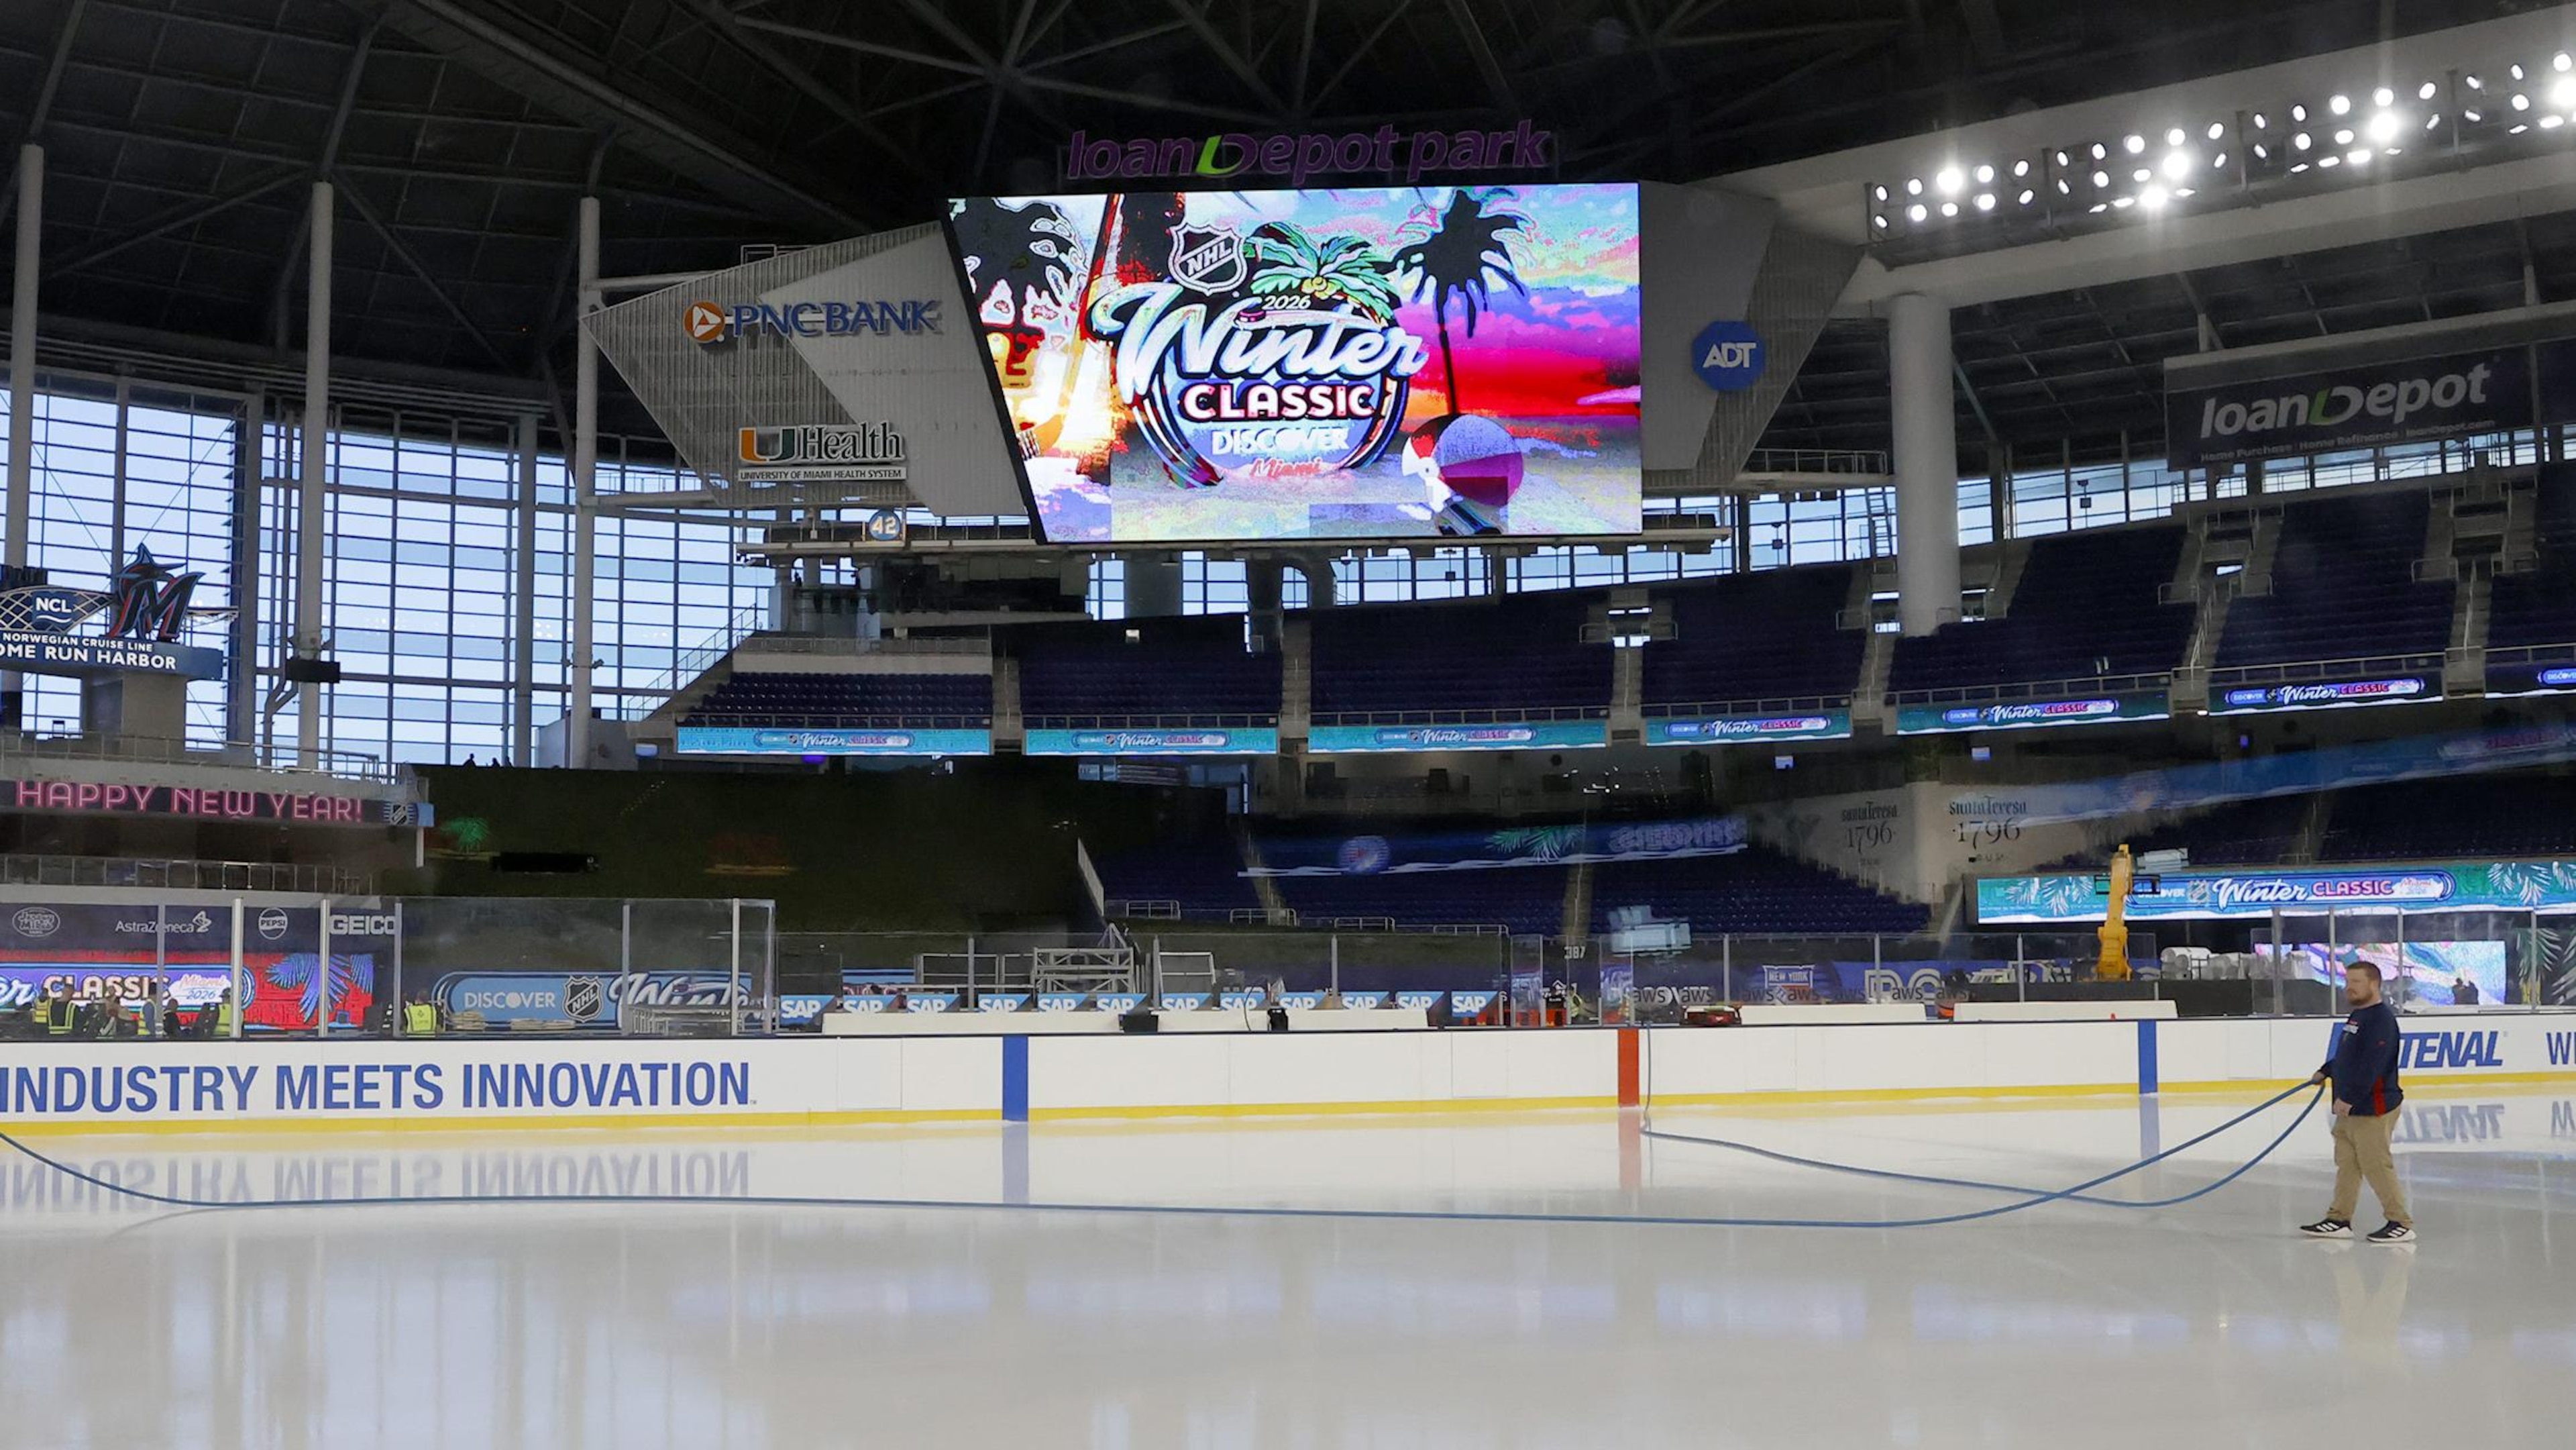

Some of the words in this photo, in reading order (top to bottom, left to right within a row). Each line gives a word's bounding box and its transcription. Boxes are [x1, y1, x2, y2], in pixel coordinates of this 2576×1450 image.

[1068, 125, 1393, 185] loanDepot
[1407, 119, 1551, 183] park
[1186, 242, 1233, 275] NHL
[1263, 295, 1311, 309] 2026
[1091, 282, 1430, 404] Winter
[1703, 342, 1756, 368] ADT
[1183, 384, 1375, 419] CLASSIC
[2200, 363, 2491, 439] loanDepot
[1212, 427, 1349, 456] DISCOVER
[2300, 437, 2334, 450] Home
[2337, 431, 2399, 446] Refinance
[741, 471, 788, 480] UNIVERSITY
[790, 471, 801, 479] OF
[804, 470, 832, 478] MIAMI
[835, 470, 865, 478] HEALTH
[868, 470, 901, 478] SYSTEM
[872, 515, 896, 534] 42
[36, 597, 72, 613] NCL
[3, 633, 78, 645] NORWEGIAN
[82, 638, 123, 649] CRUISE
[127, 642, 153, 652] LINE
[45, 645, 89, 662] RUN
[97, 649, 176, 670] HARBOR
[2281, 685, 2339, 705] Winter
[2340, 684, 2389, 694] CLASSIC
[1991, 705, 2041, 723] Winter
[2044, 703, 2088, 714] CLASSIC
[1421, 729, 1467, 744] Winter
[1712, 721, 1759, 737] Winter
[800, 733, 847, 749] Winter
[1118, 733, 1162, 750] Winter
[16, 779, 154, 812] HAPPY
[170, 787, 258, 817] NEW
[270, 793, 363, 824] YEAR!
[2213, 878, 2308, 909] Winter
[2313, 880, 2394, 896] CLASSIC
[115, 921, 195, 933] AstraZneca
[329, 915, 395, 935] GEICO
[1564, 946, 1586, 959] 387
[1768, 971, 1785, 981] NEW
[1788, 970, 1809, 981] YORK
[186, 990, 216, 1000] 2026
[464, 992, 555, 1008] DISCOVER
[571, 988, 598, 1012] NHL
[1633, 989, 1666, 1004] aws
[1682, 988, 1712, 1003] aws
[1746, 988, 1774, 1001] aws
[1788, 988, 1819, 1001] aws
[1892, 986, 1923, 1000] aws
[781, 1000, 821, 1019] SAP
[843, 1000, 883, 1013] SAP
[908, 999, 946, 1013] SAP
[978, 999, 1018, 1012] SAP
[1038, 998, 1077, 1012] SAP
[1097, 998, 1136, 1012] SAP
[1162, 998, 1199, 1011] SAP
[1220, 997, 1257, 1010] SAP
[1279, 997, 1316, 1011] SAP
[1342, 996, 1378, 1009] SAP
[1398, 996, 1433, 1009] SAP
[1452, 996, 1486, 1013] SAP
[0, 1066, 259, 1113] INDUSTRY
[276, 1063, 443, 1110] MEETS
[463, 1062, 749, 1108] INNOVATION
